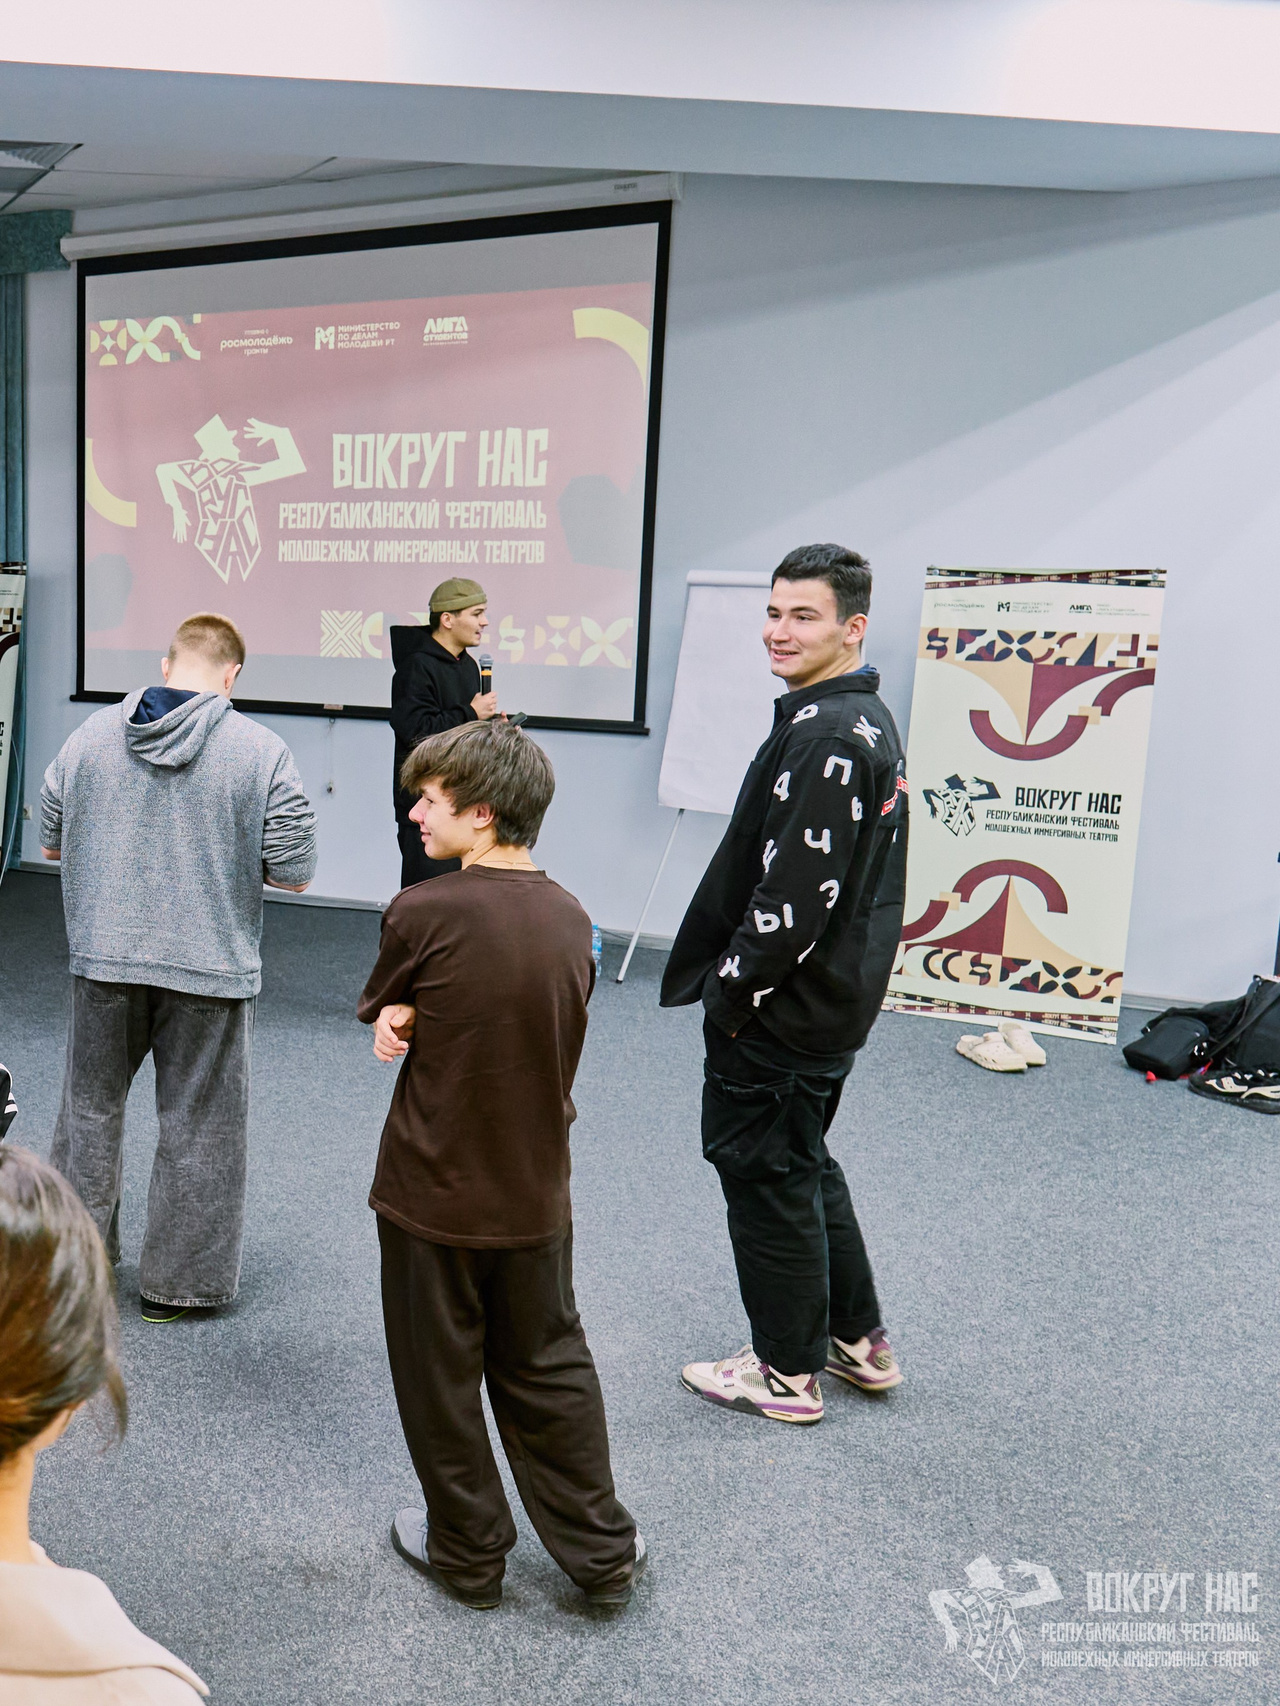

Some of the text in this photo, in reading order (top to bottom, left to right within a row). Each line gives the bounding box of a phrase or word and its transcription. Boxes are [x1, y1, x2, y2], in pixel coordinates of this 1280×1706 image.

[338, 322, 400, 332] МИНИСТЕРСТВО
[424, 316, 468, 333] ЛИГА
[338, 332, 378, 341] ПО ДЕЛАМ
[338, 339, 395, 349] МОЛОДЕЖИ РТ
[332, 427, 549, 489] ВОКРУГ НАС
[278, 498, 547, 529] РЕСПУБЛИКАНСКИЙ ФЕСТИВАЛЬ
[278, 539, 545, 563] МОЛОДЕЖНЫХ ИММЕРСИВНЫХ ТЕАТРОВ
[1015, 786, 1122, 815] ВОКРУГ НАС
[985, 809, 1120, 830] РЕСПУБЛИКАНСКИЙ ФЕСТИВАЛЬ
[984, 823, 1119, 843] МОЛОДЕЖНЫХ ИММЕРСИВНЫХ ТЕАТРОВ
